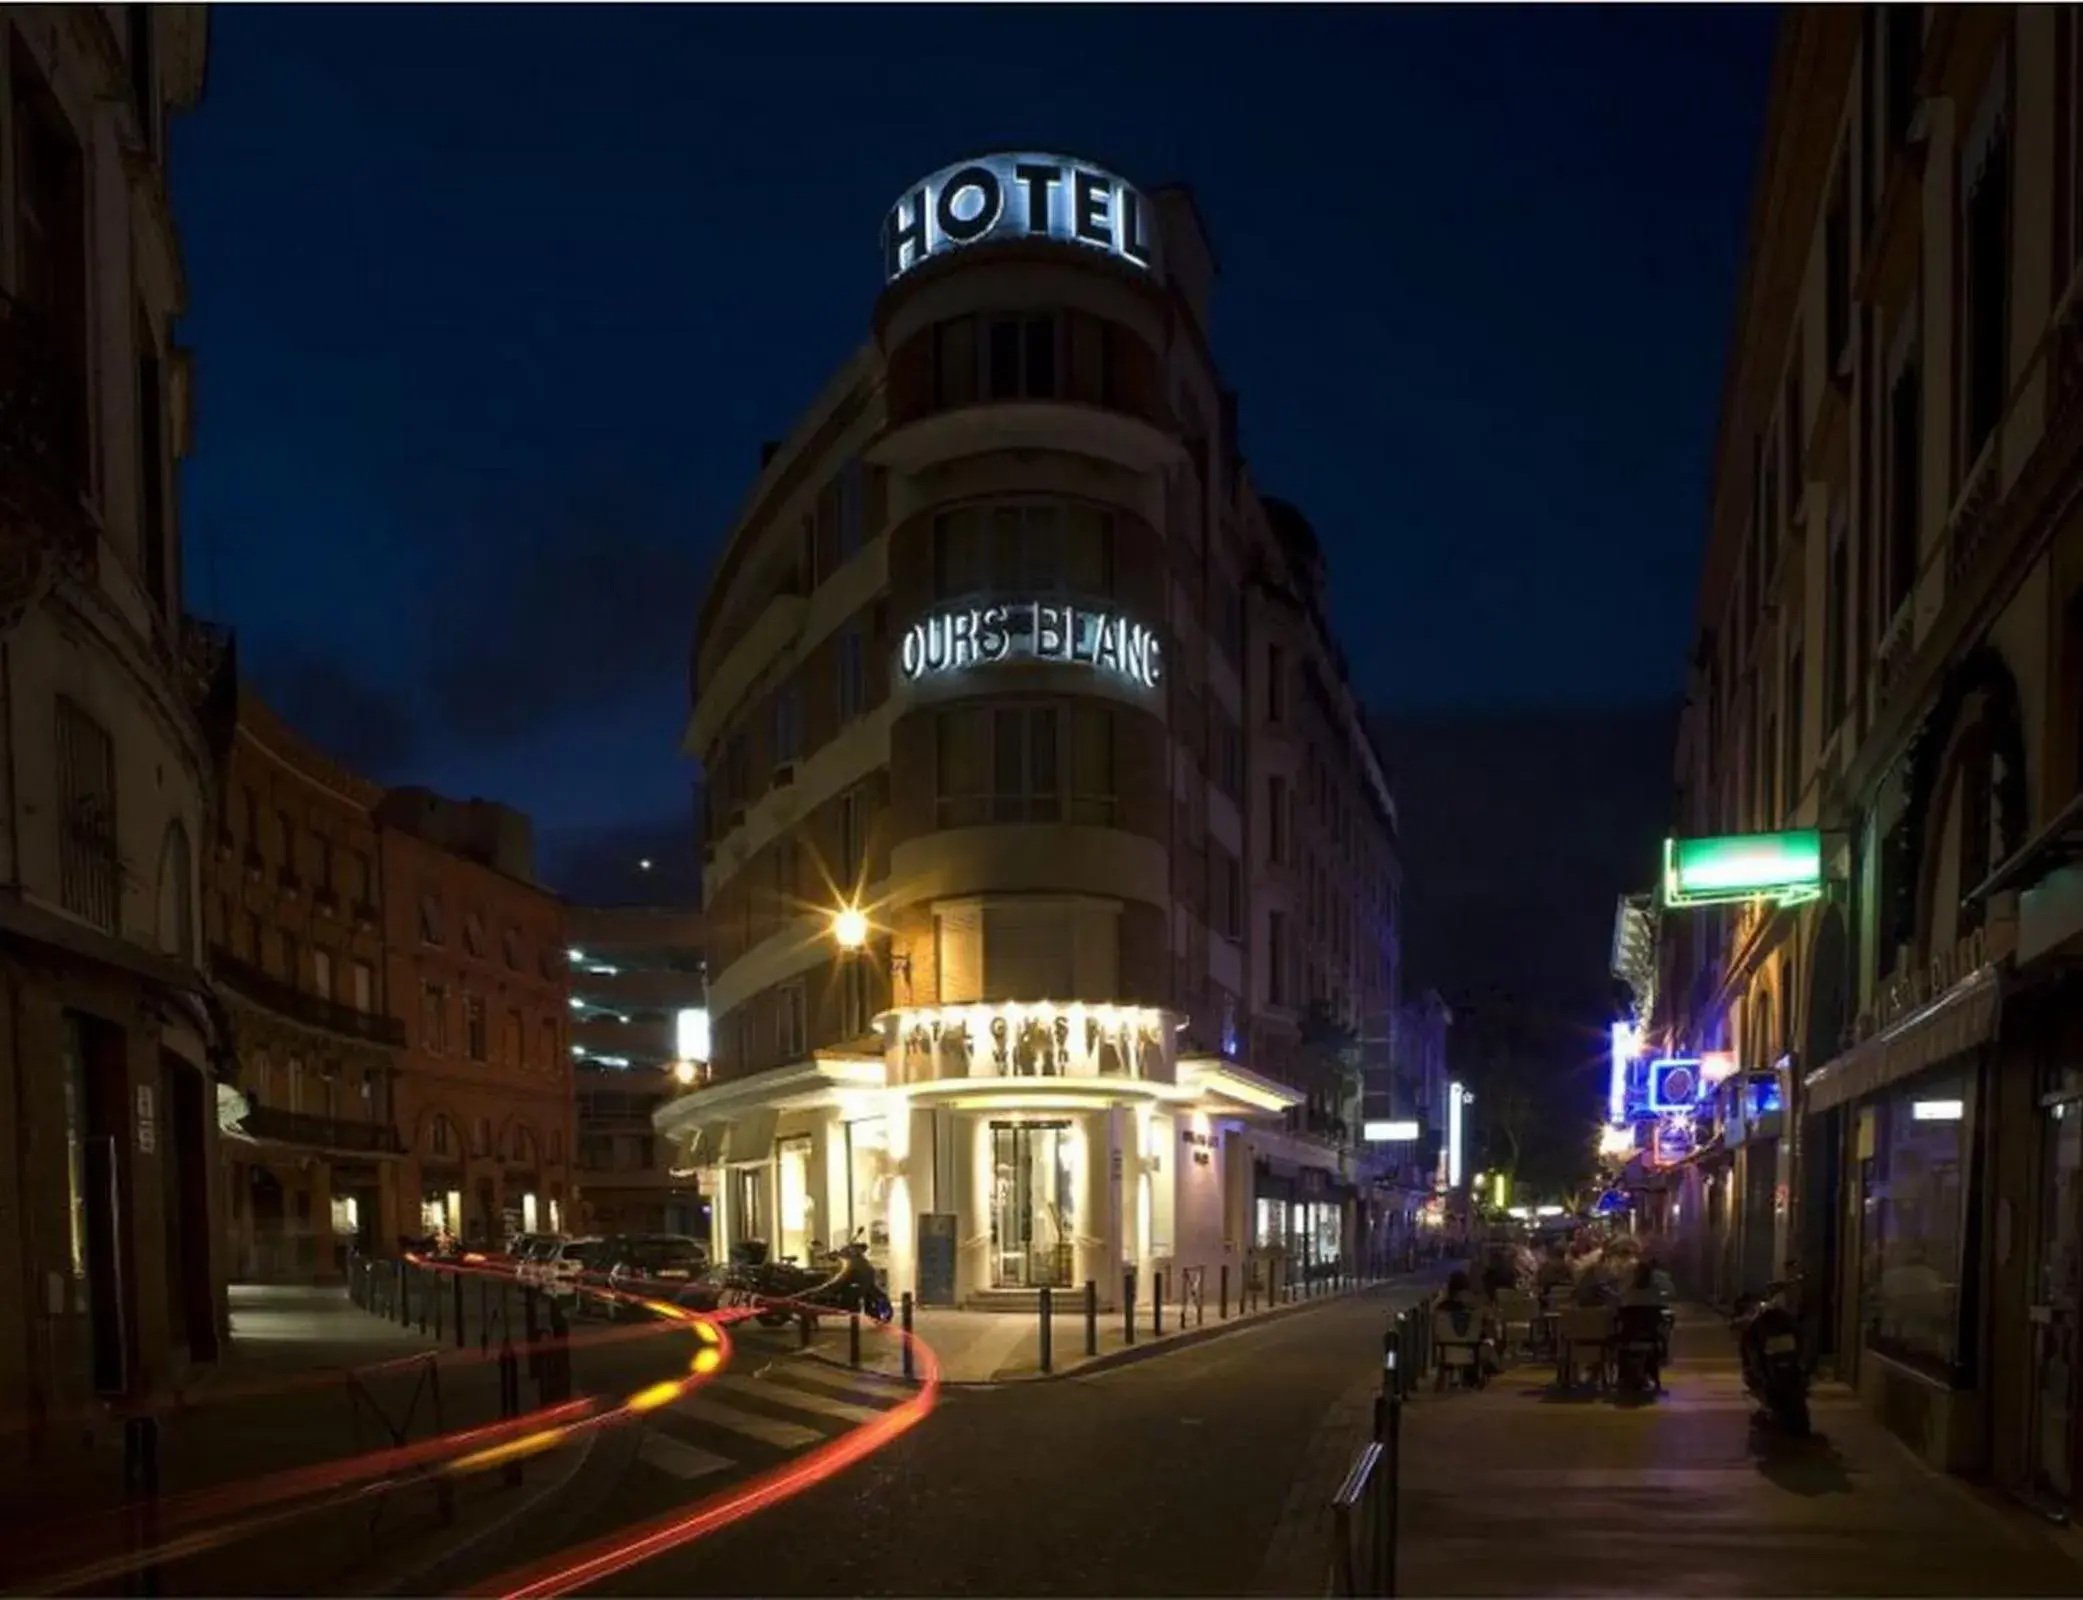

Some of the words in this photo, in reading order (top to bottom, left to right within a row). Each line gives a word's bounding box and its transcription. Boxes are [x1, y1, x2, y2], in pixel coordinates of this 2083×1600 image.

[887, 164, 1151, 280] HOTEL
[902, 607, 1011, 681] OURS
[1032, 600, 1163, 688] BLANC
